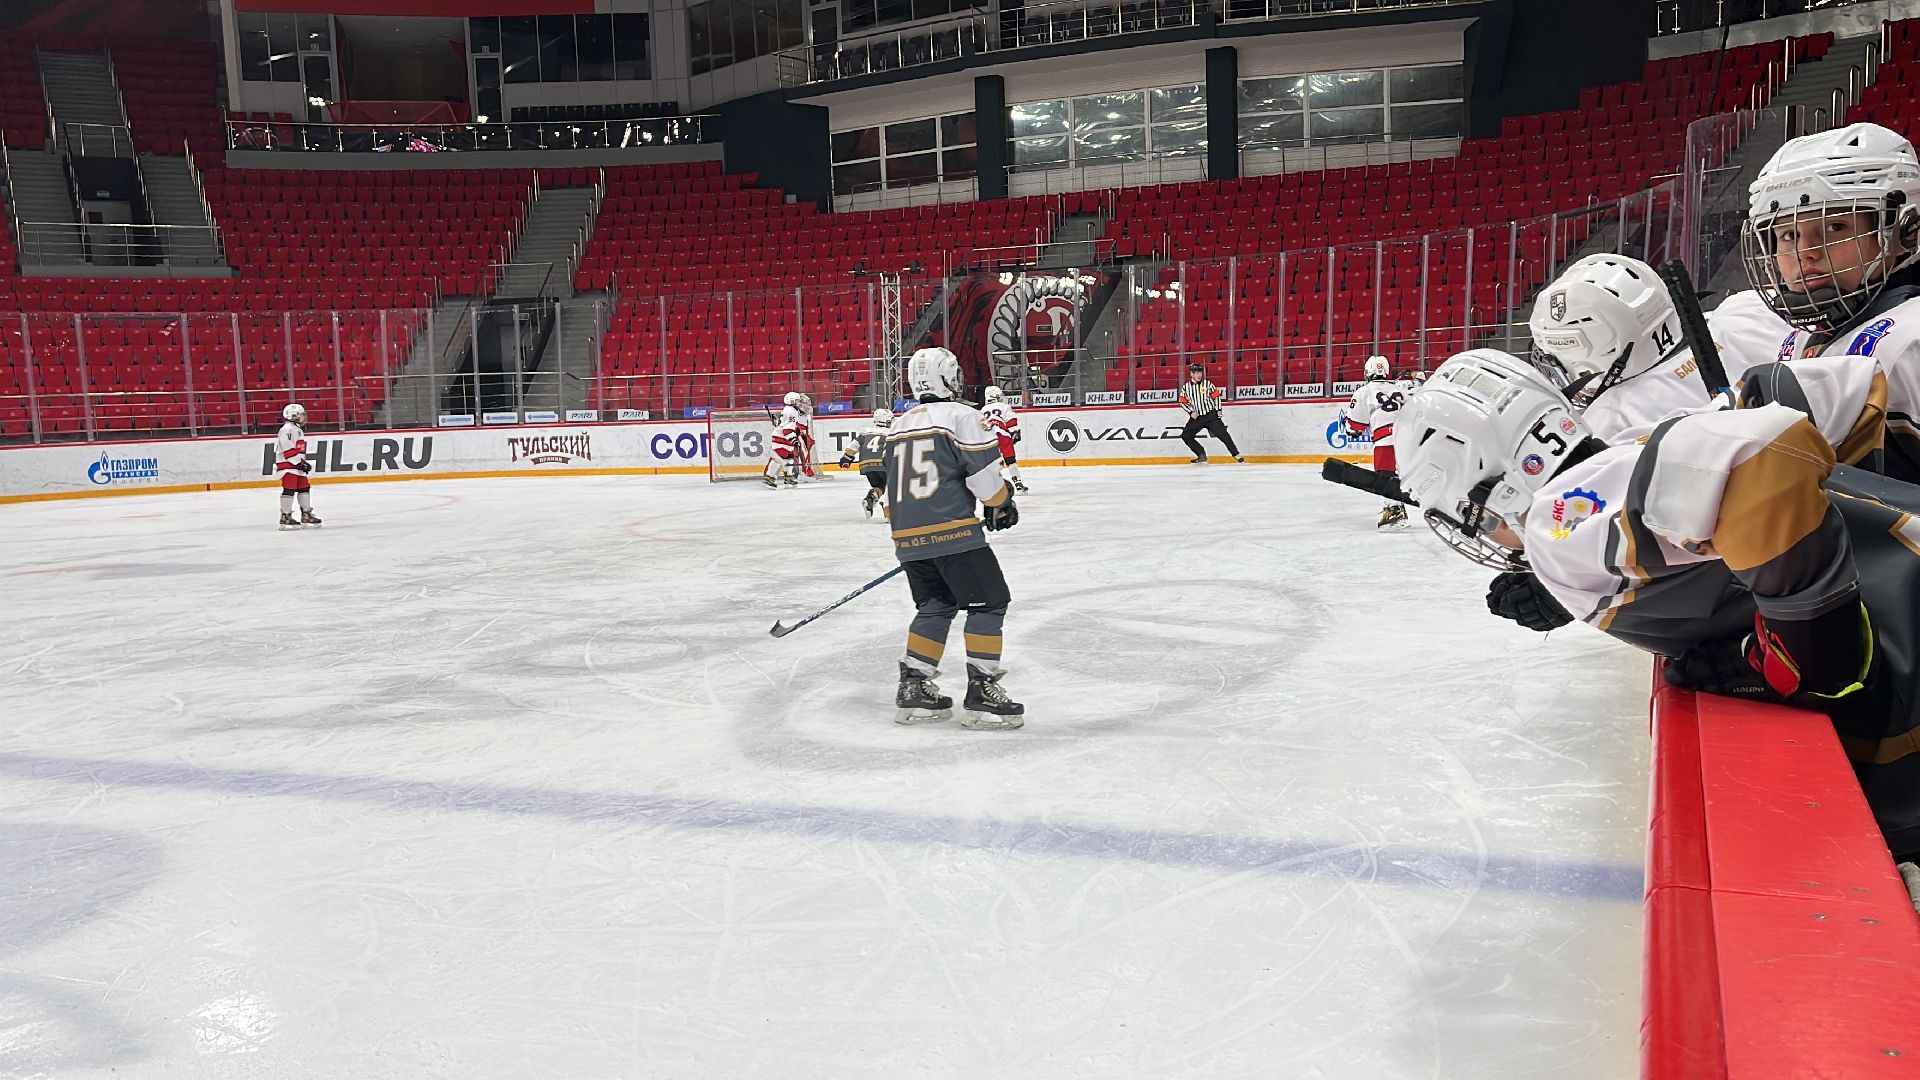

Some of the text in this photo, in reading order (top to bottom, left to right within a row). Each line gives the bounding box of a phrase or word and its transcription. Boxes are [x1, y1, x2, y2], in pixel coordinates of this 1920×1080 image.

[1651, 321, 1675, 357] 14
[917, 381, 930, 392] 15
[1238, 387, 1273, 396] KHL.RU
[1286, 385, 1321, 394] KHL.RU
[1035, 395, 1069, 404] KHL.RU
[1087, 393, 1122, 402] KHL.RU
[1140, 391, 1174, 400] KHL.RU
[1530, 420, 1567, 456] 5
[508, 431, 592, 463] ТУЛЬСКИЙ
[111, 458, 158, 471] ГАЗПРОМ
[893, 438, 940, 503] 15
[1552, 499, 1565, 522] БКС
